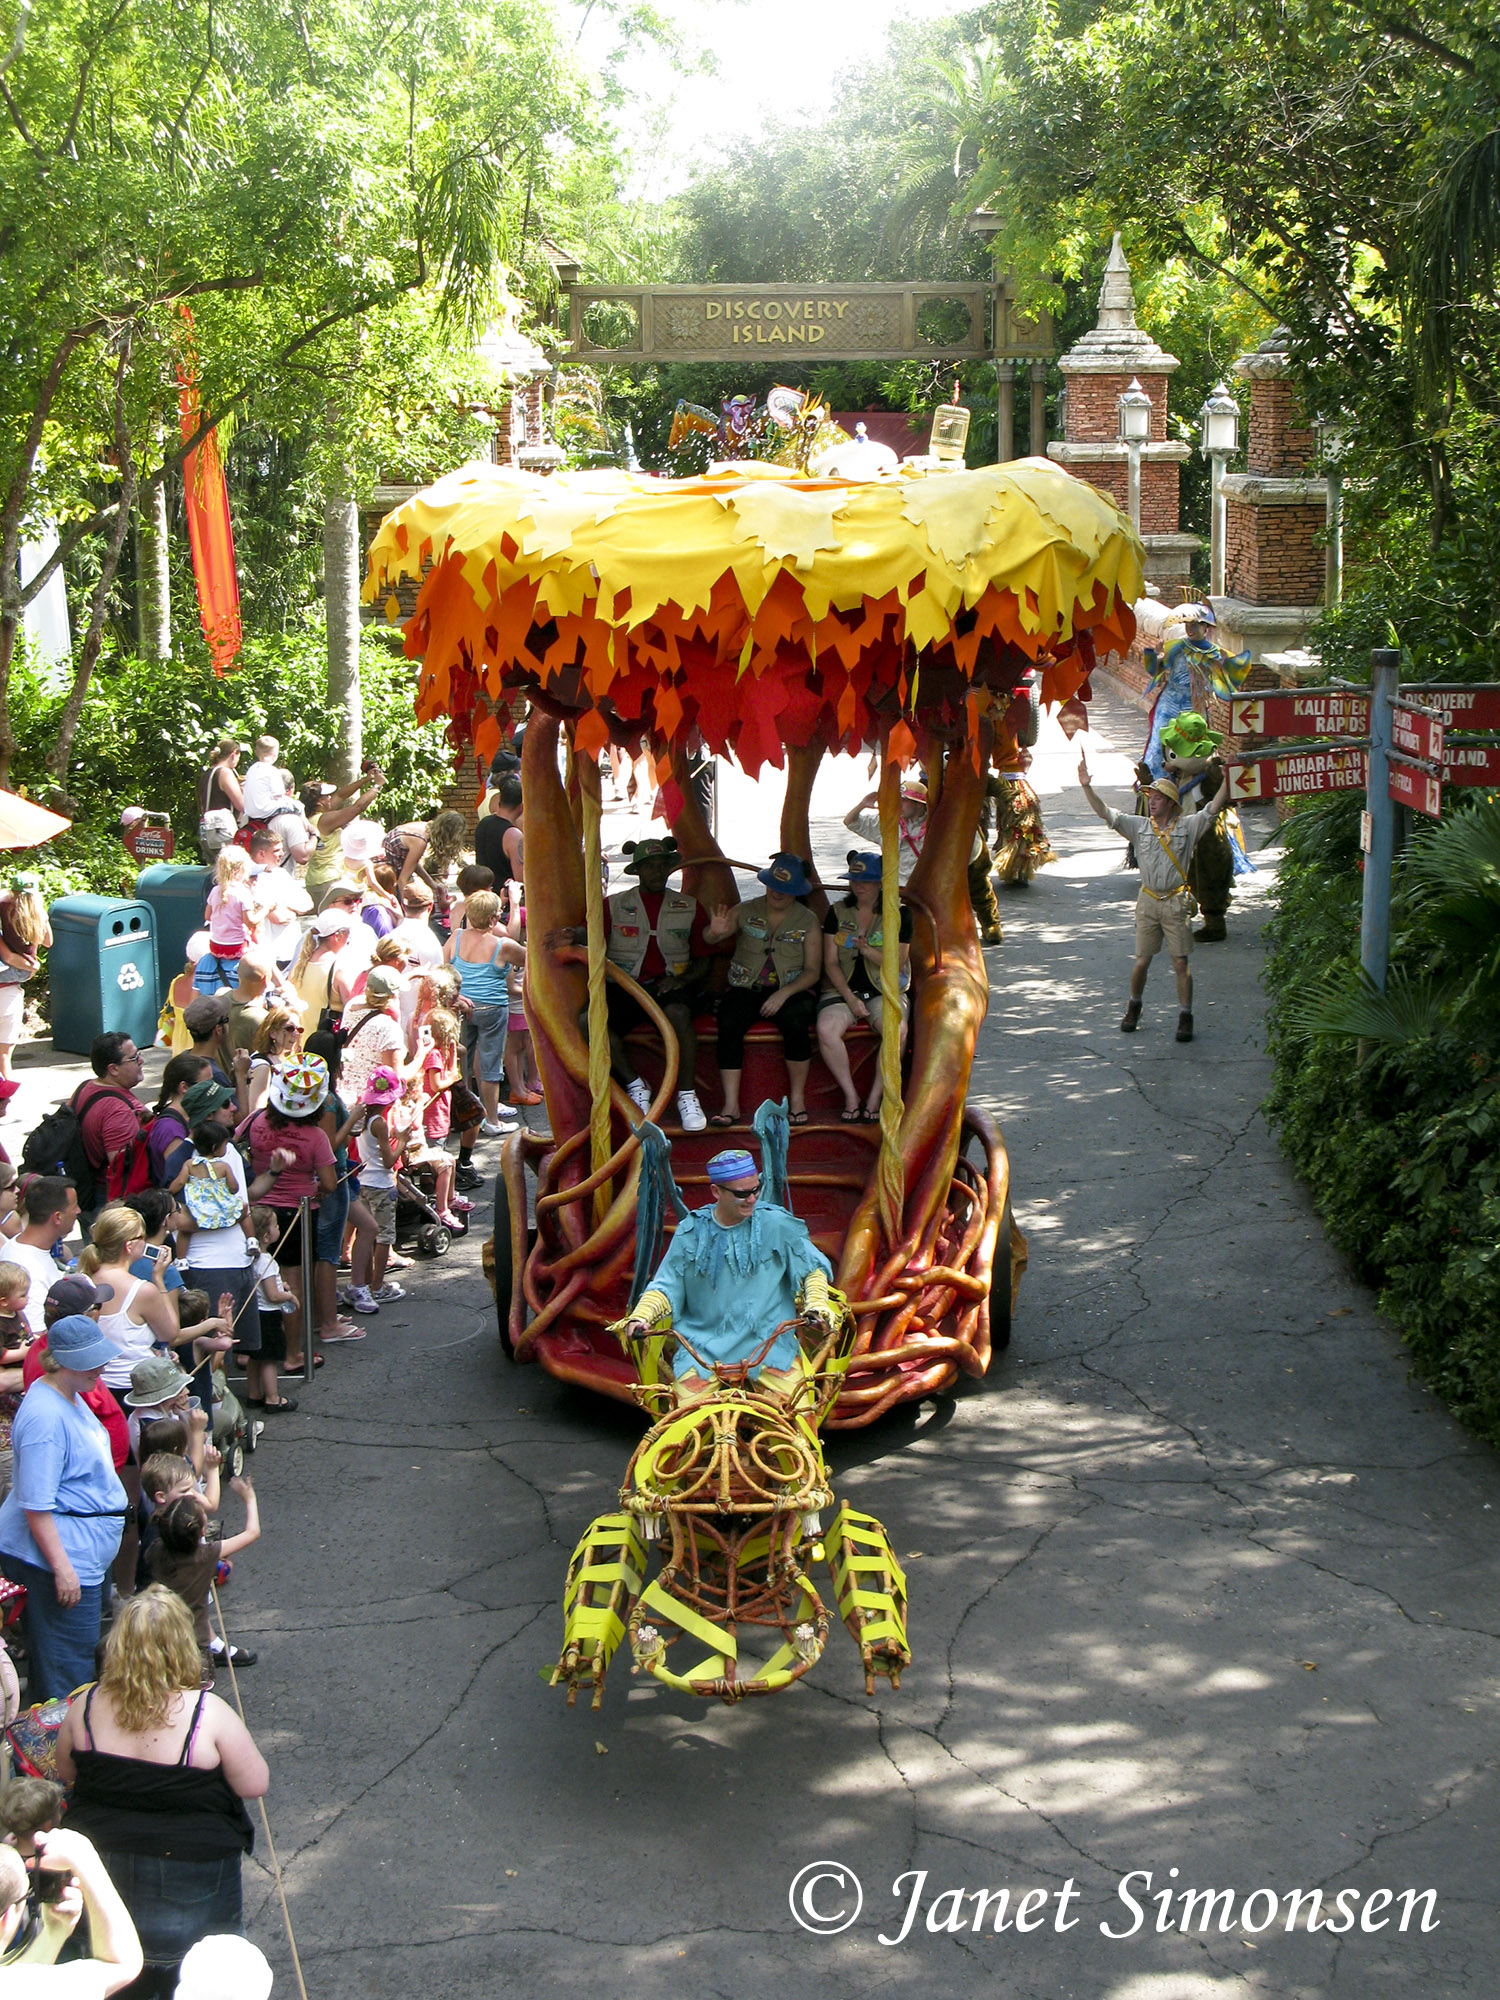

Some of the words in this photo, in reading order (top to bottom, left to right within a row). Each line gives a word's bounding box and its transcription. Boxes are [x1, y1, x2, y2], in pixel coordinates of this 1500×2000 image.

[706, 301, 849, 320] DISCOVERY
[733, 325, 825, 344] ISLAND
[1294, 700, 1325, 715] KALI
[1329, 700, 1368, 715] RIVER
[1315, 717, 1366, 732] RAPIDS
[1276, 752, 1361, 776] MAHARAJAH
[1273, 773, 1324, 793] JUNGLE
[1328, 769, 1362, 787] TREK
[135, 846, 165, 855] DRINKS
